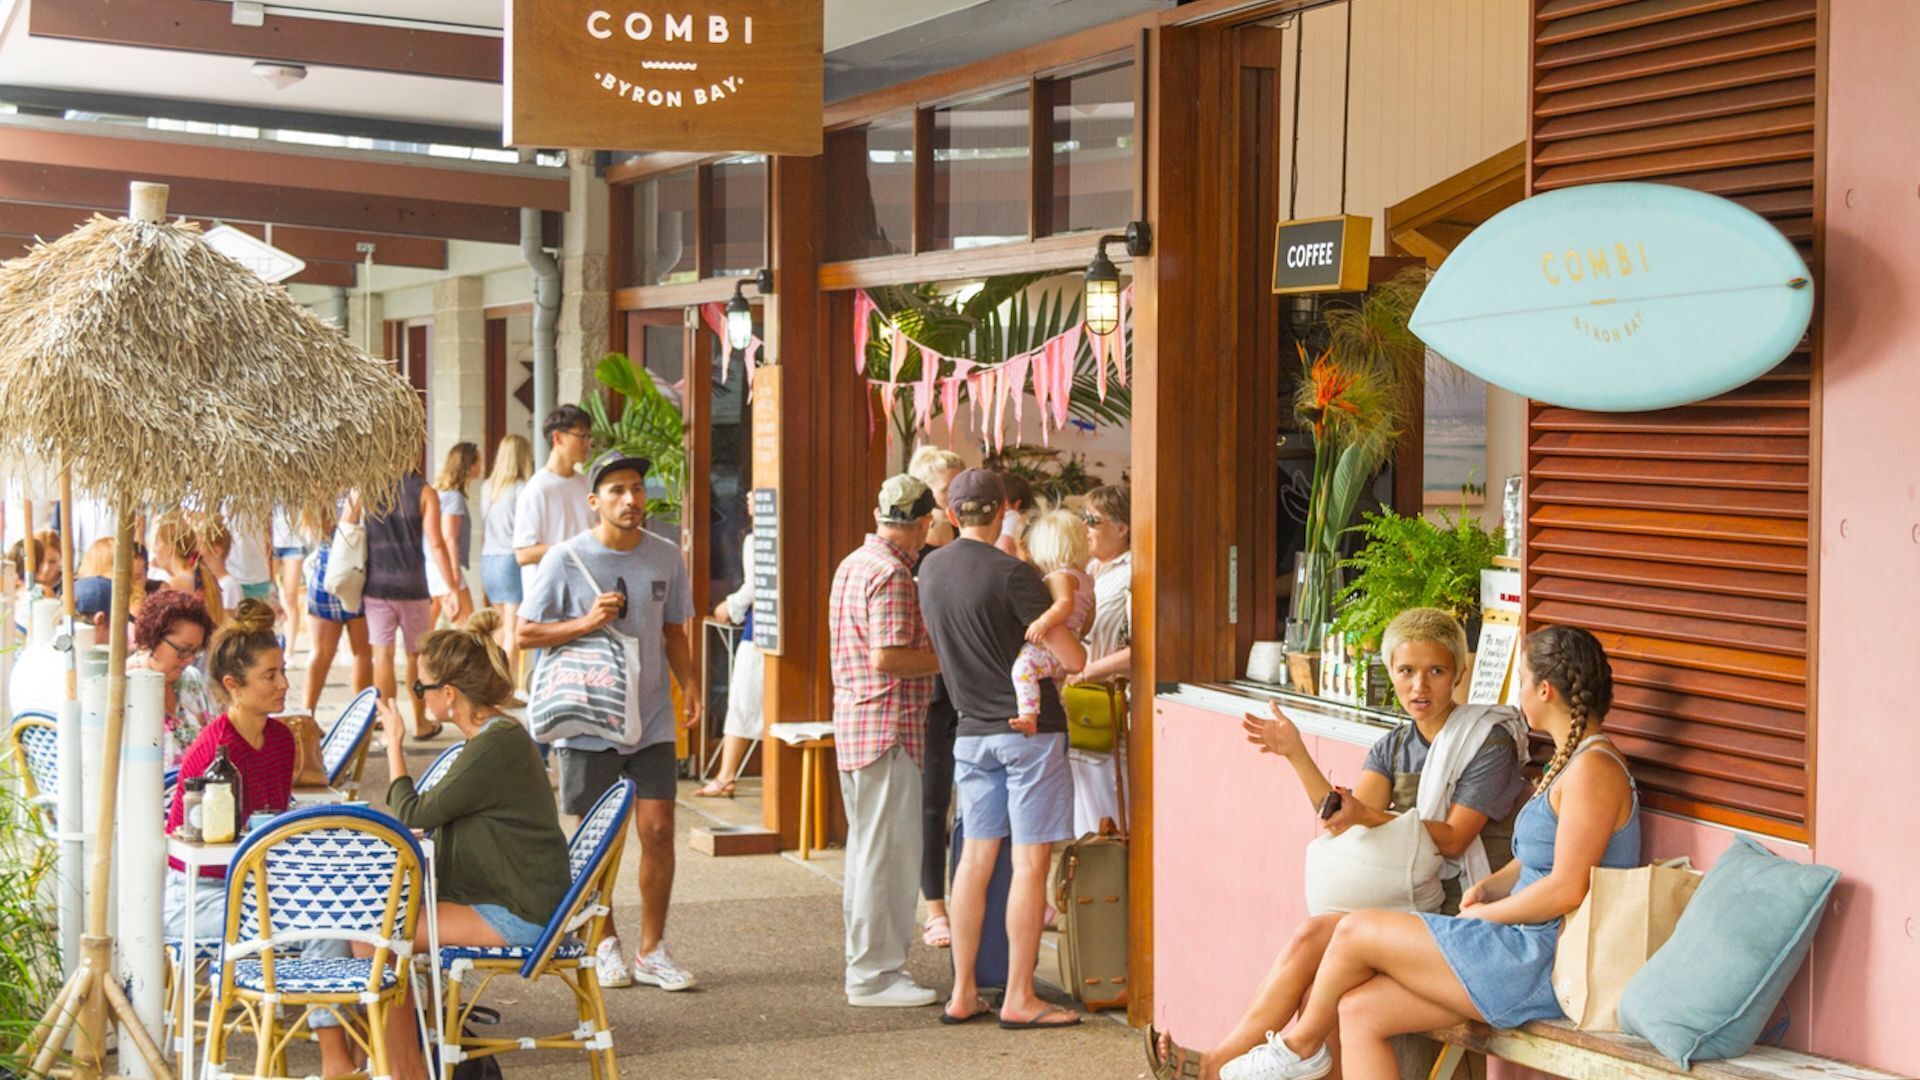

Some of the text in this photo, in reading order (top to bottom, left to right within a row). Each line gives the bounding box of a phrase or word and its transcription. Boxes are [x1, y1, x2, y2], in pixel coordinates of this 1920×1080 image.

[586, 10, 753, 44] COMBI
[601, 73, 737, 108] BYRON BAY
[1286, 241, 1335, 269] COFFEE
[1541, 239, 1649, 286] COMBI
[1572, 309, 1644, 343] BYRON BAY
[541, 661, 616, 699] Sparkle
